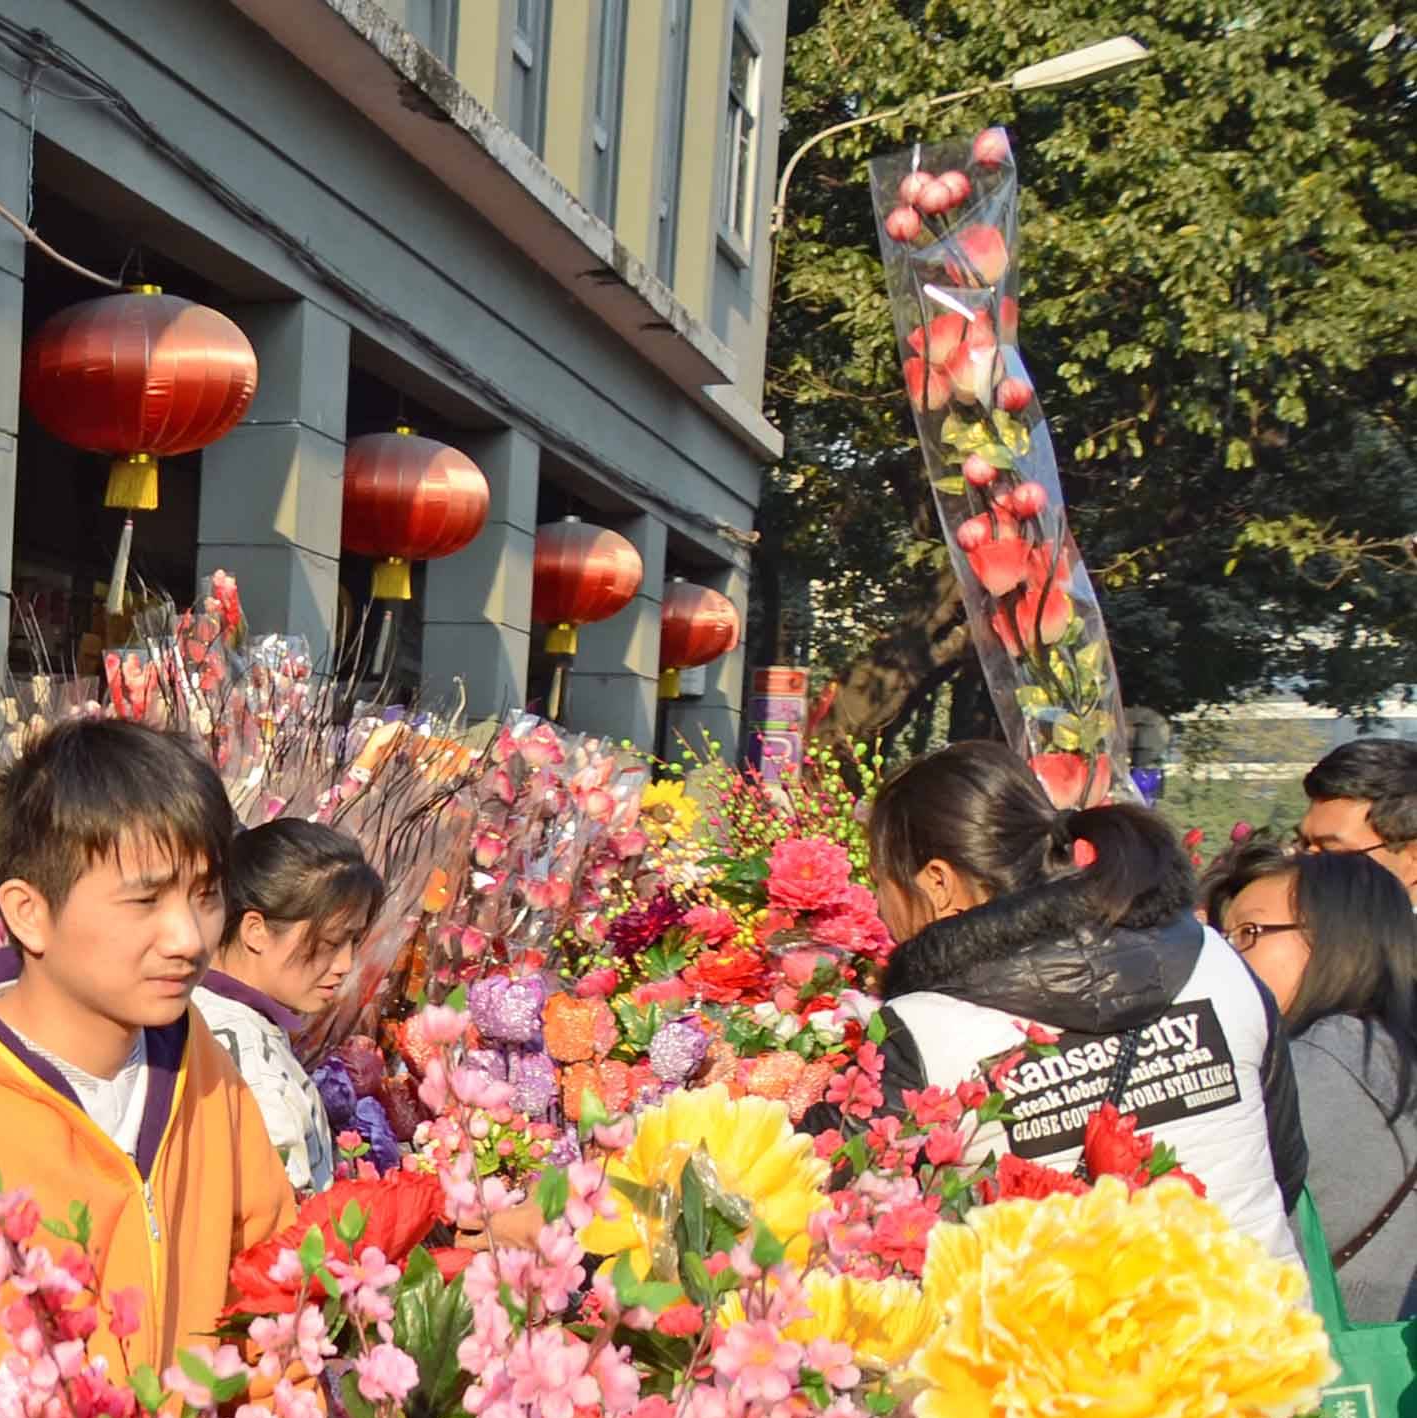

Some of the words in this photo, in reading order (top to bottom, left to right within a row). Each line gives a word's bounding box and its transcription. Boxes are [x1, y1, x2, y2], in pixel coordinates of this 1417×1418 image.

[1012, 1111, 1061, 1143] CLOSE
[1119, 1079, 1168, 1115] FORE
[1061, 1077, 1113, 1105] lobst
